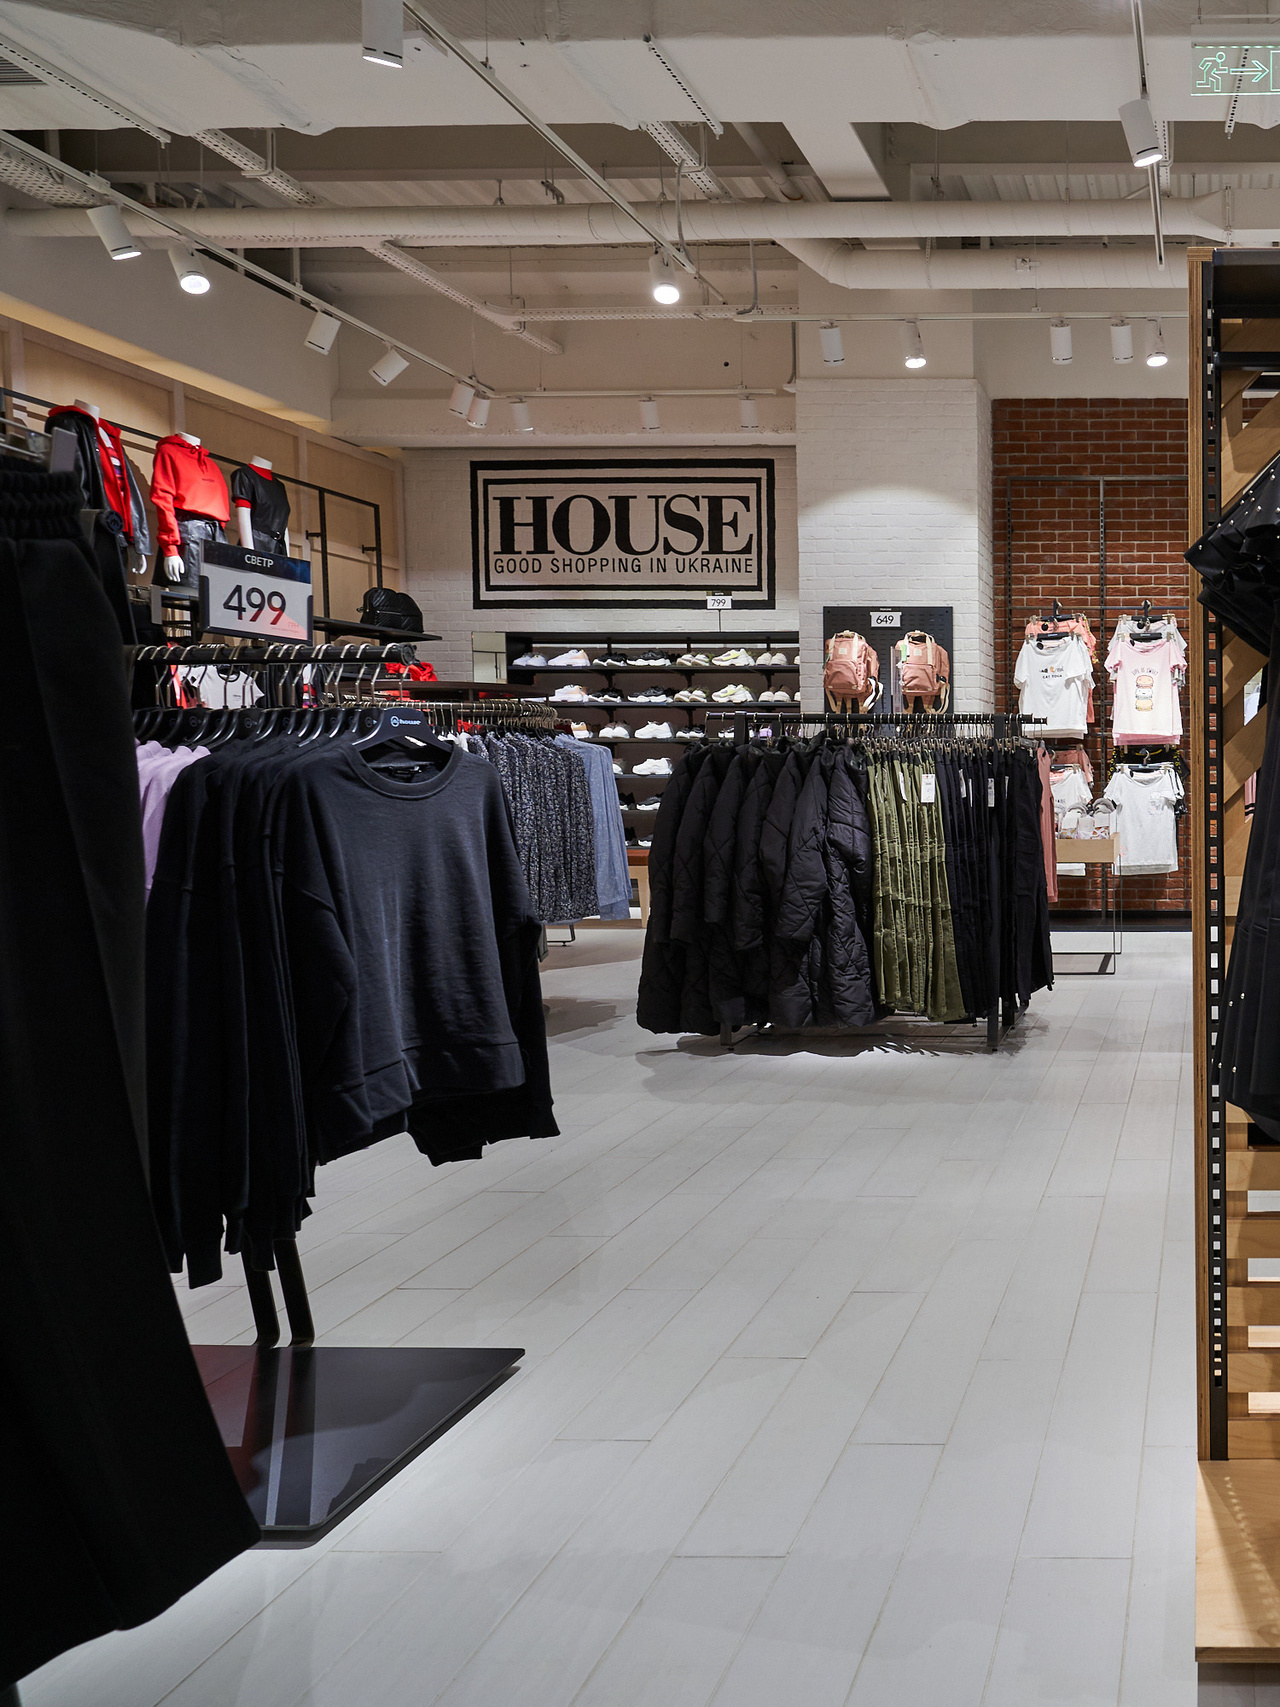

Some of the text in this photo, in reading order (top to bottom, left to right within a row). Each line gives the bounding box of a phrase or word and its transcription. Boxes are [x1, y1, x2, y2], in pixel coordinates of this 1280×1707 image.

[493, 493, 754, 556] HOUSE
[244, 554, 274, 568] СВЕТР
[494, 557, 753, 573] GOOD SHOPPING IN UKRAINE
[223, 584, 287, 626] 499
[711, 598, 727, 607] 799
[875, 615, 895, 625] 649
